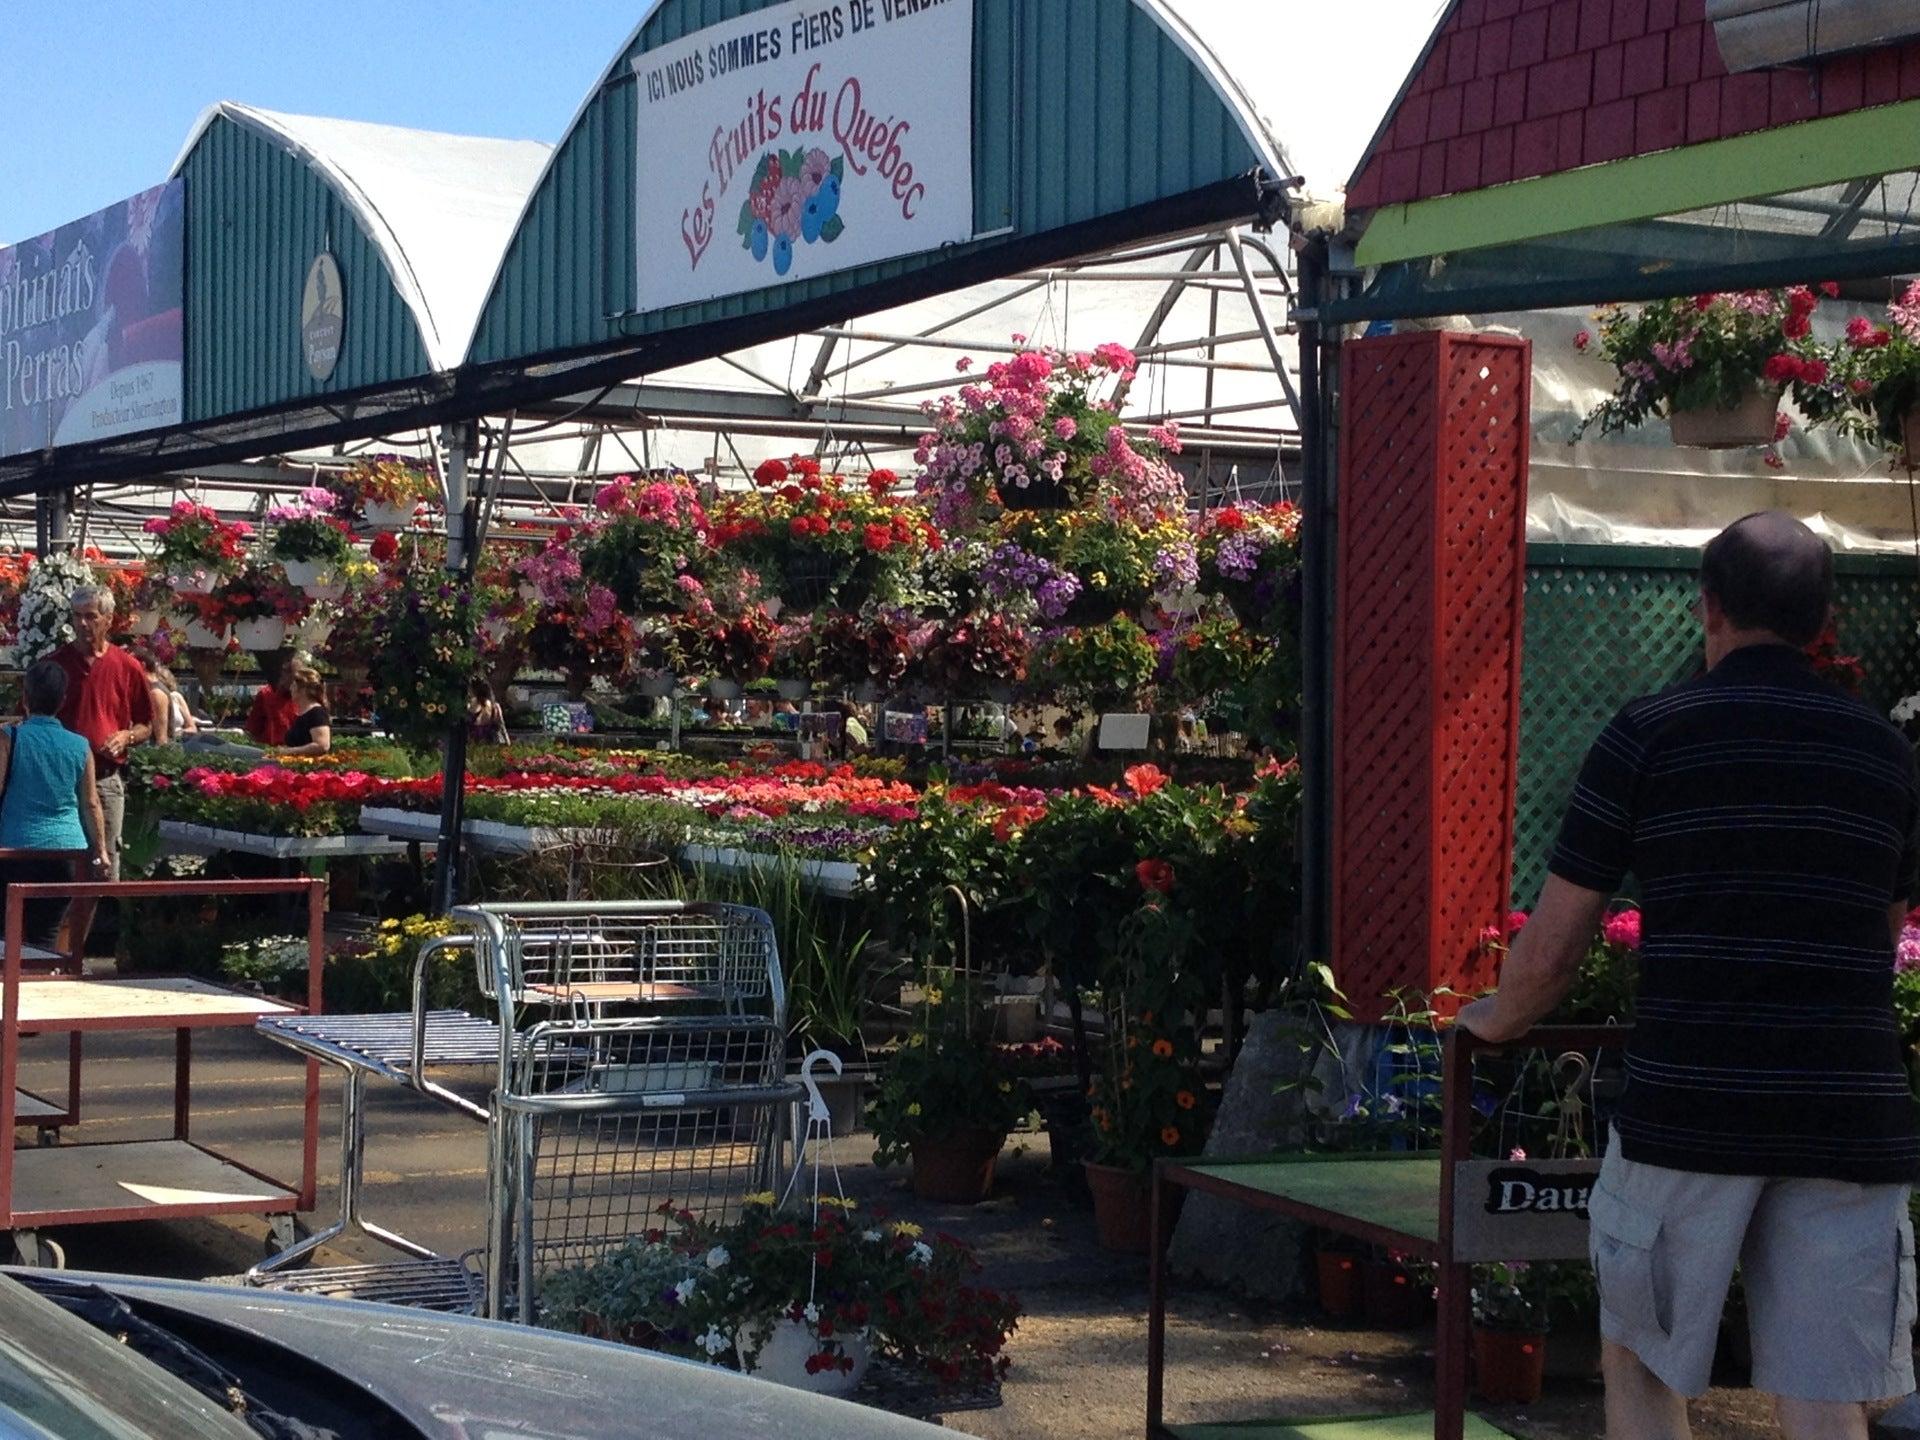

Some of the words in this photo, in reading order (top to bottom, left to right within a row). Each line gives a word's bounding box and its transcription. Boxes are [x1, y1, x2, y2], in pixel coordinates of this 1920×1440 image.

[647, 73, 666, 103] ICI
[668, 50, 704, 96] NOUS
[709, 28, 782, 79] SOMMES
[791, 17, 844, 54] FIERS
[851, 2, 876, 35] DE
[882, 0, 952, 22] VEN
[681, 180, 714, 272] Les
[708, 88, 782, 197] Fruits
[790, 63, 828, 136] du
[832, 77, 925, 220] Québec
[6, 340, 83, 410] Perras
